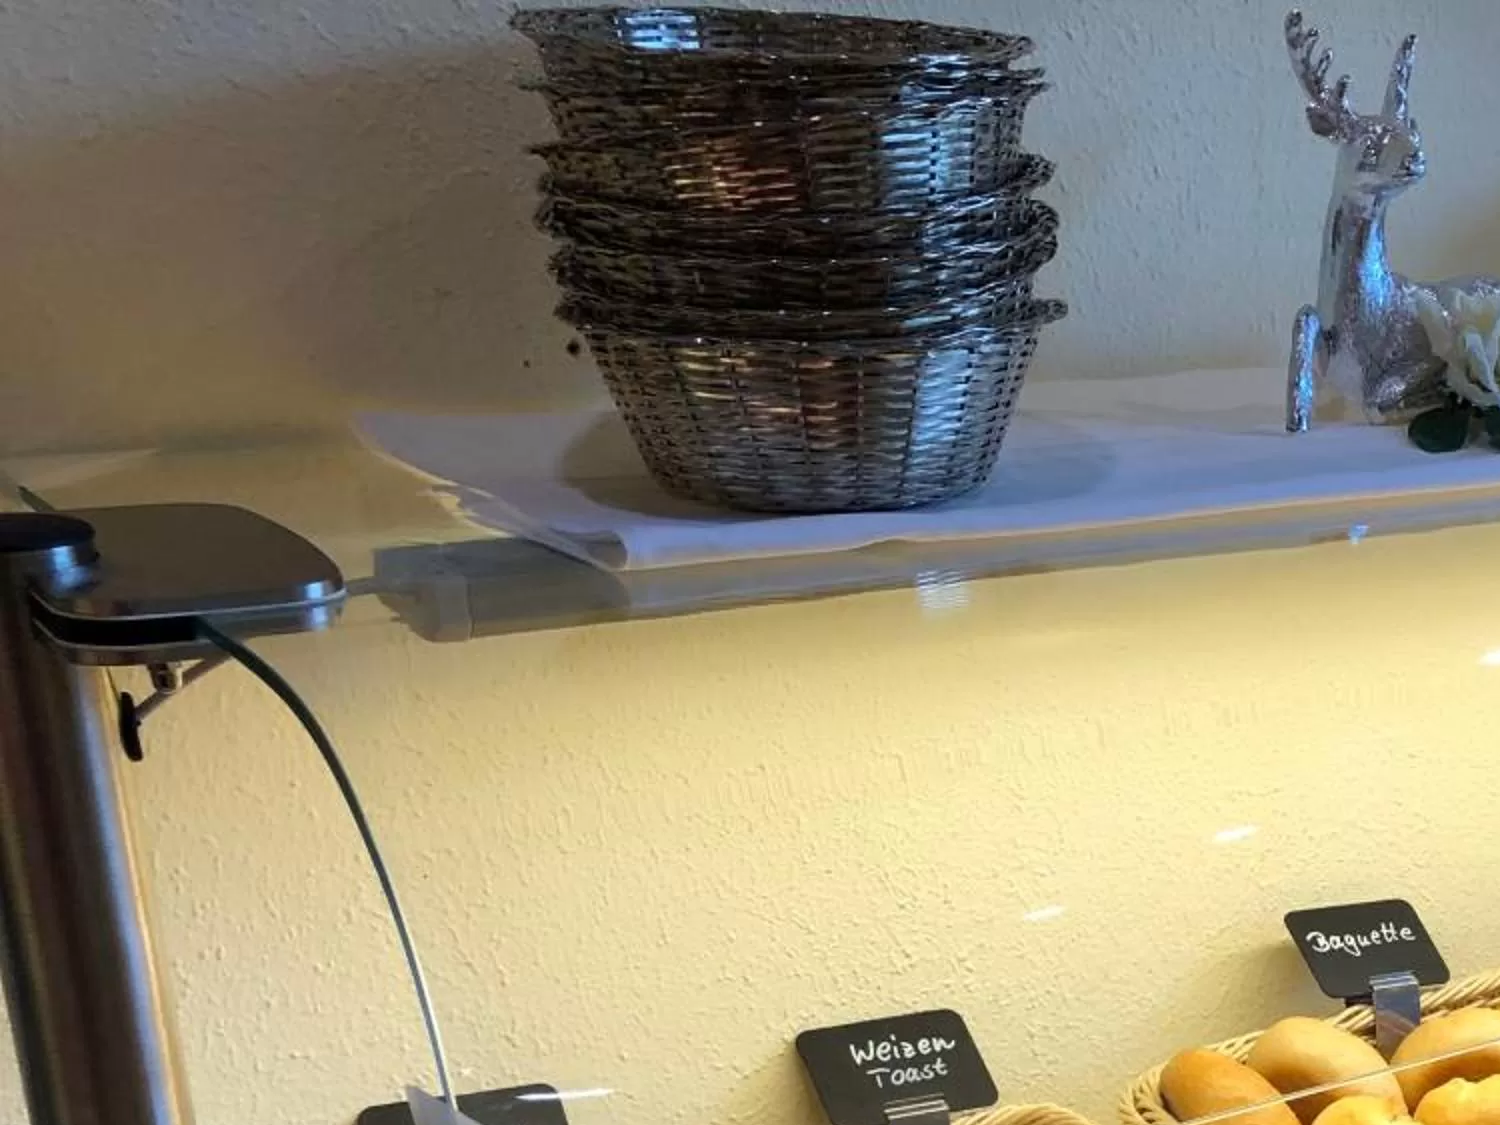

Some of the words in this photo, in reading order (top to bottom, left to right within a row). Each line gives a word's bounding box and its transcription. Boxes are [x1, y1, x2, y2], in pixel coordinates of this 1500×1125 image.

[1305, 921, 1416, 957] Baguette
[849, 1033, 955, 1066] Weizen
[865, 1057, 948, 1088] Toast
